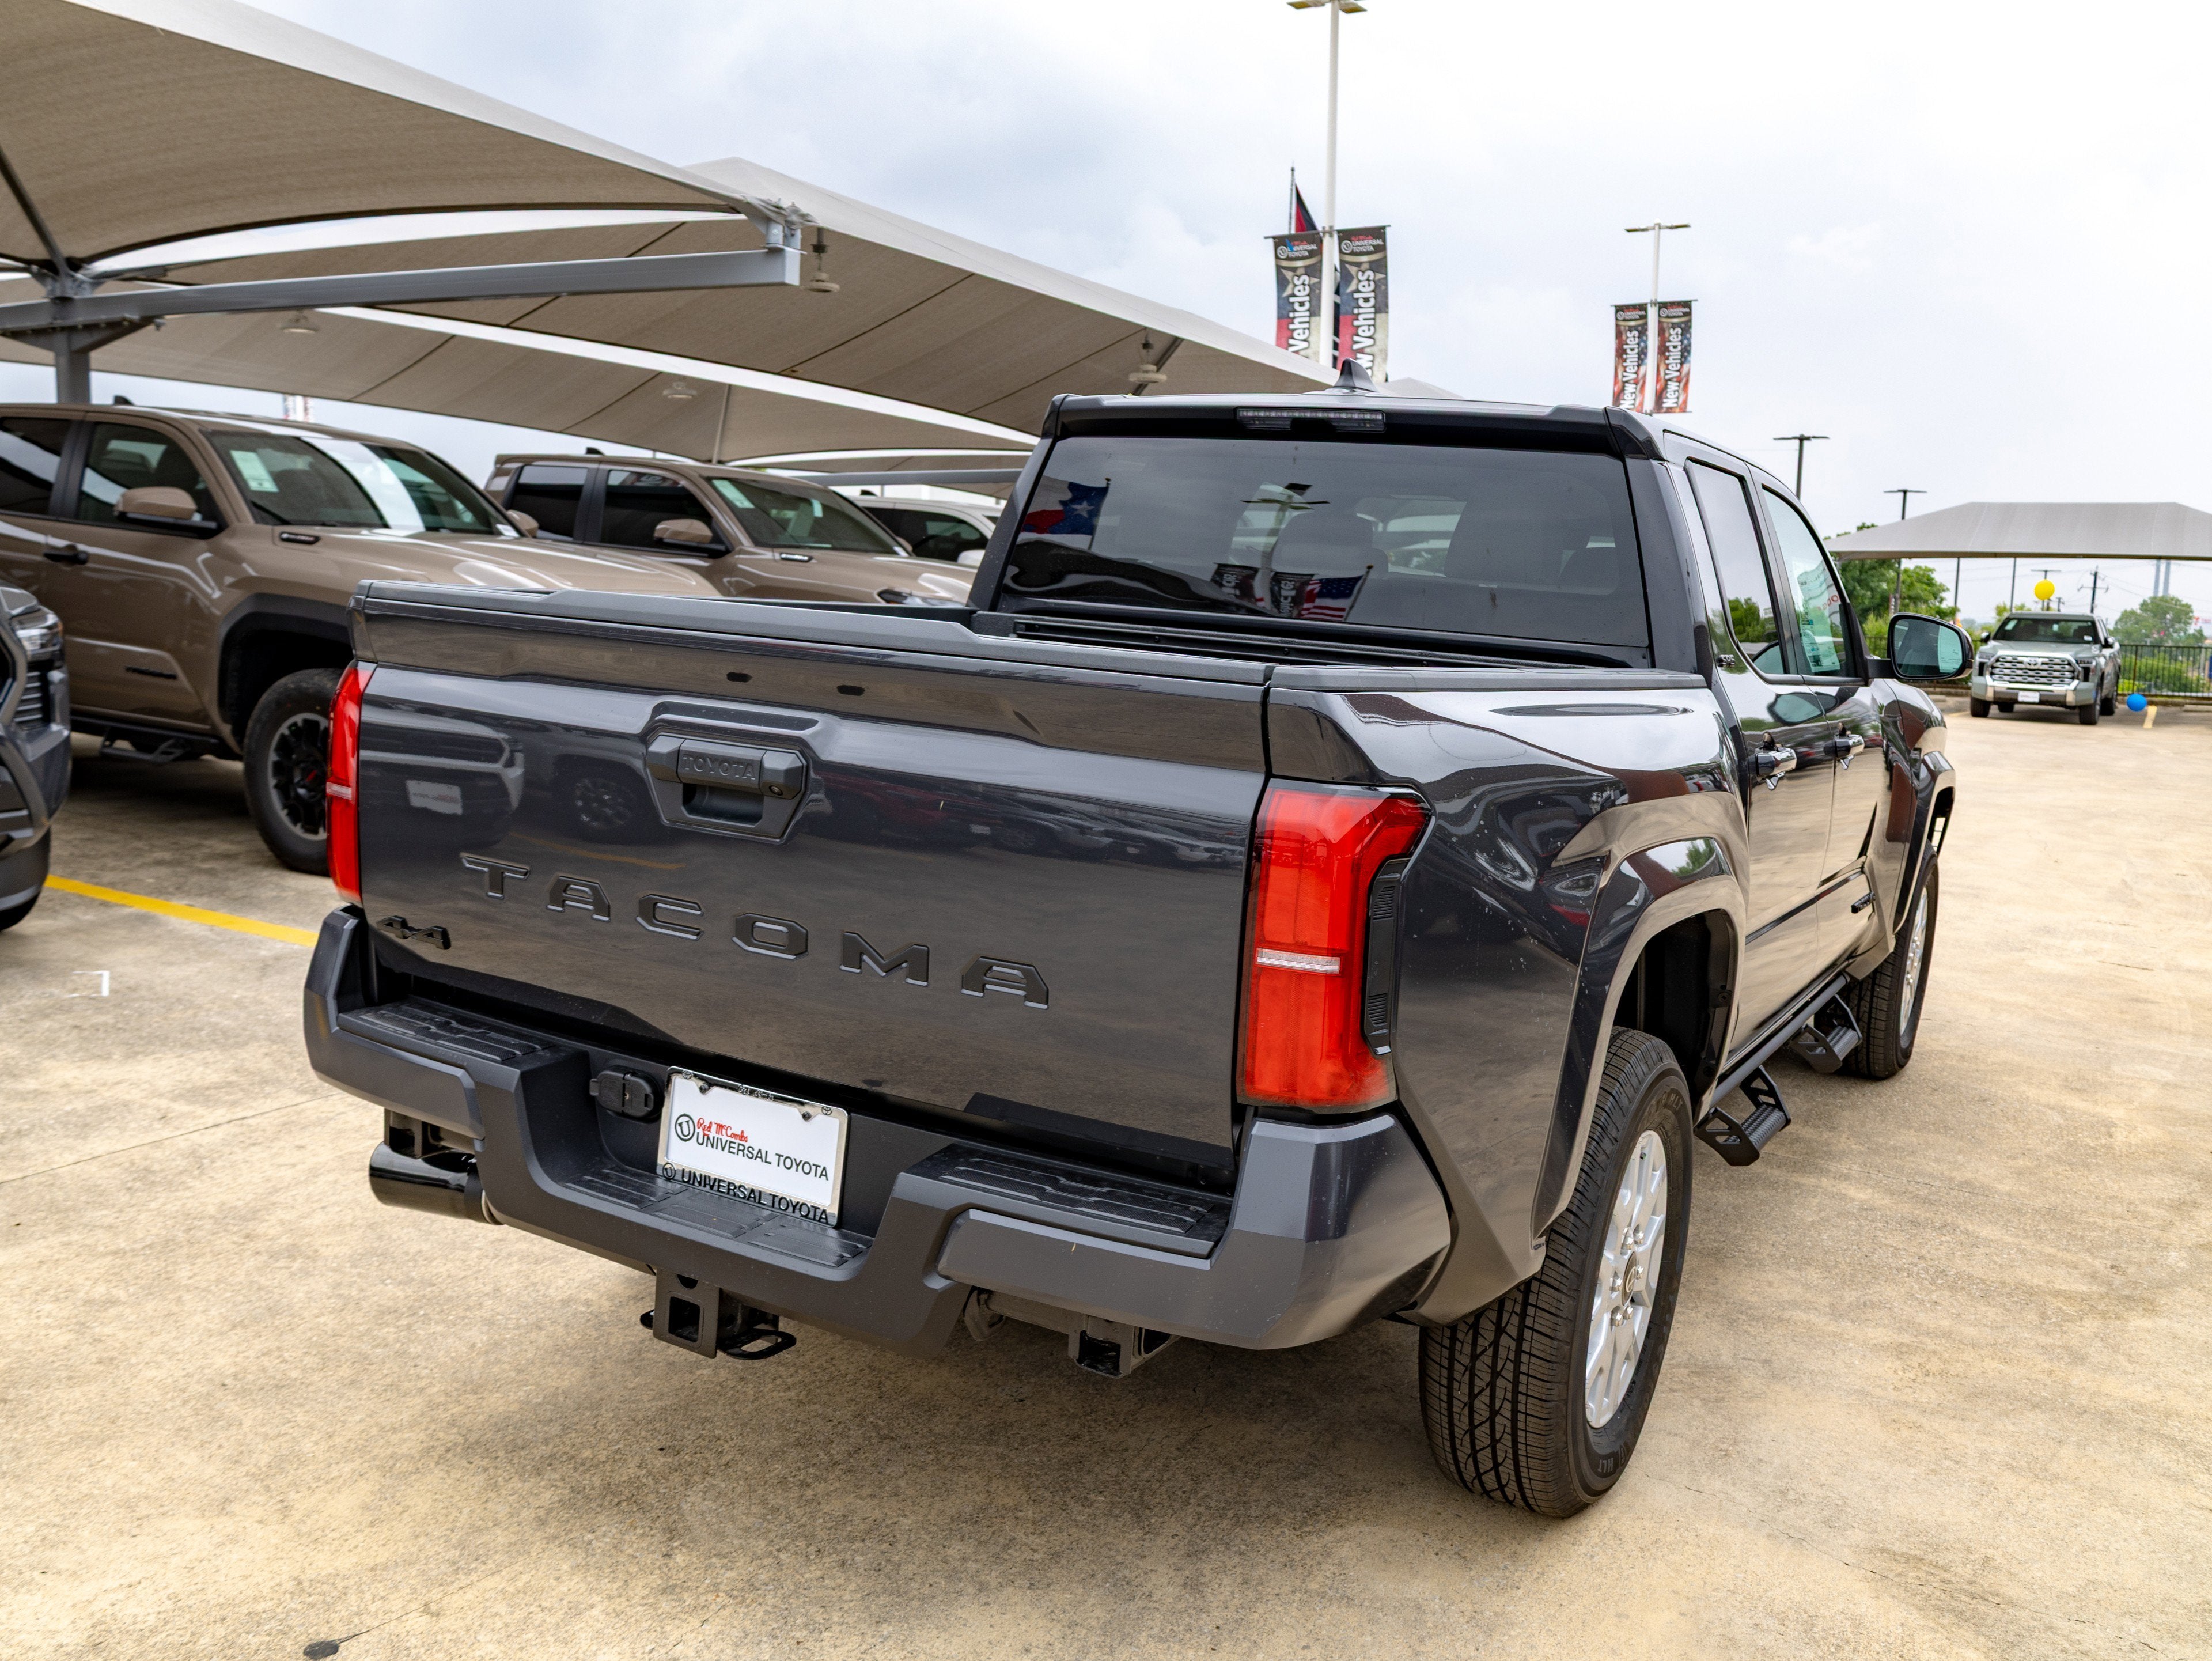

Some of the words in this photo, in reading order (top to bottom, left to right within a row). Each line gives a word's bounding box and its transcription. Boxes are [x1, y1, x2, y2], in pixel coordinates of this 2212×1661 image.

[1288, 274, 1310, 353] Vehicles
[1352, 269, 1376, 350] Vehicles
[1623, 330, 1639, 382] Vehicles
[1665, 327, 1682, 381] Vehicles
[1620, 382, 1636, 408] New
[1662, 380, 1680, 408] New
[683, 754, 756, 780] TOYOTA
[461, 854, 1050, 1011] TACOMA
[697, 1118, 712, 1136] Red
[714, 1121, 748, 1142] McCombs
[696, 1132, 772, 1164] UNIVERSAL
[775, 1153, 828, 1181] TOYOTA
[681, 1168, 770, 1205] UNIVERSAL
[770, 1195, 828, 1224] TOYOTA
